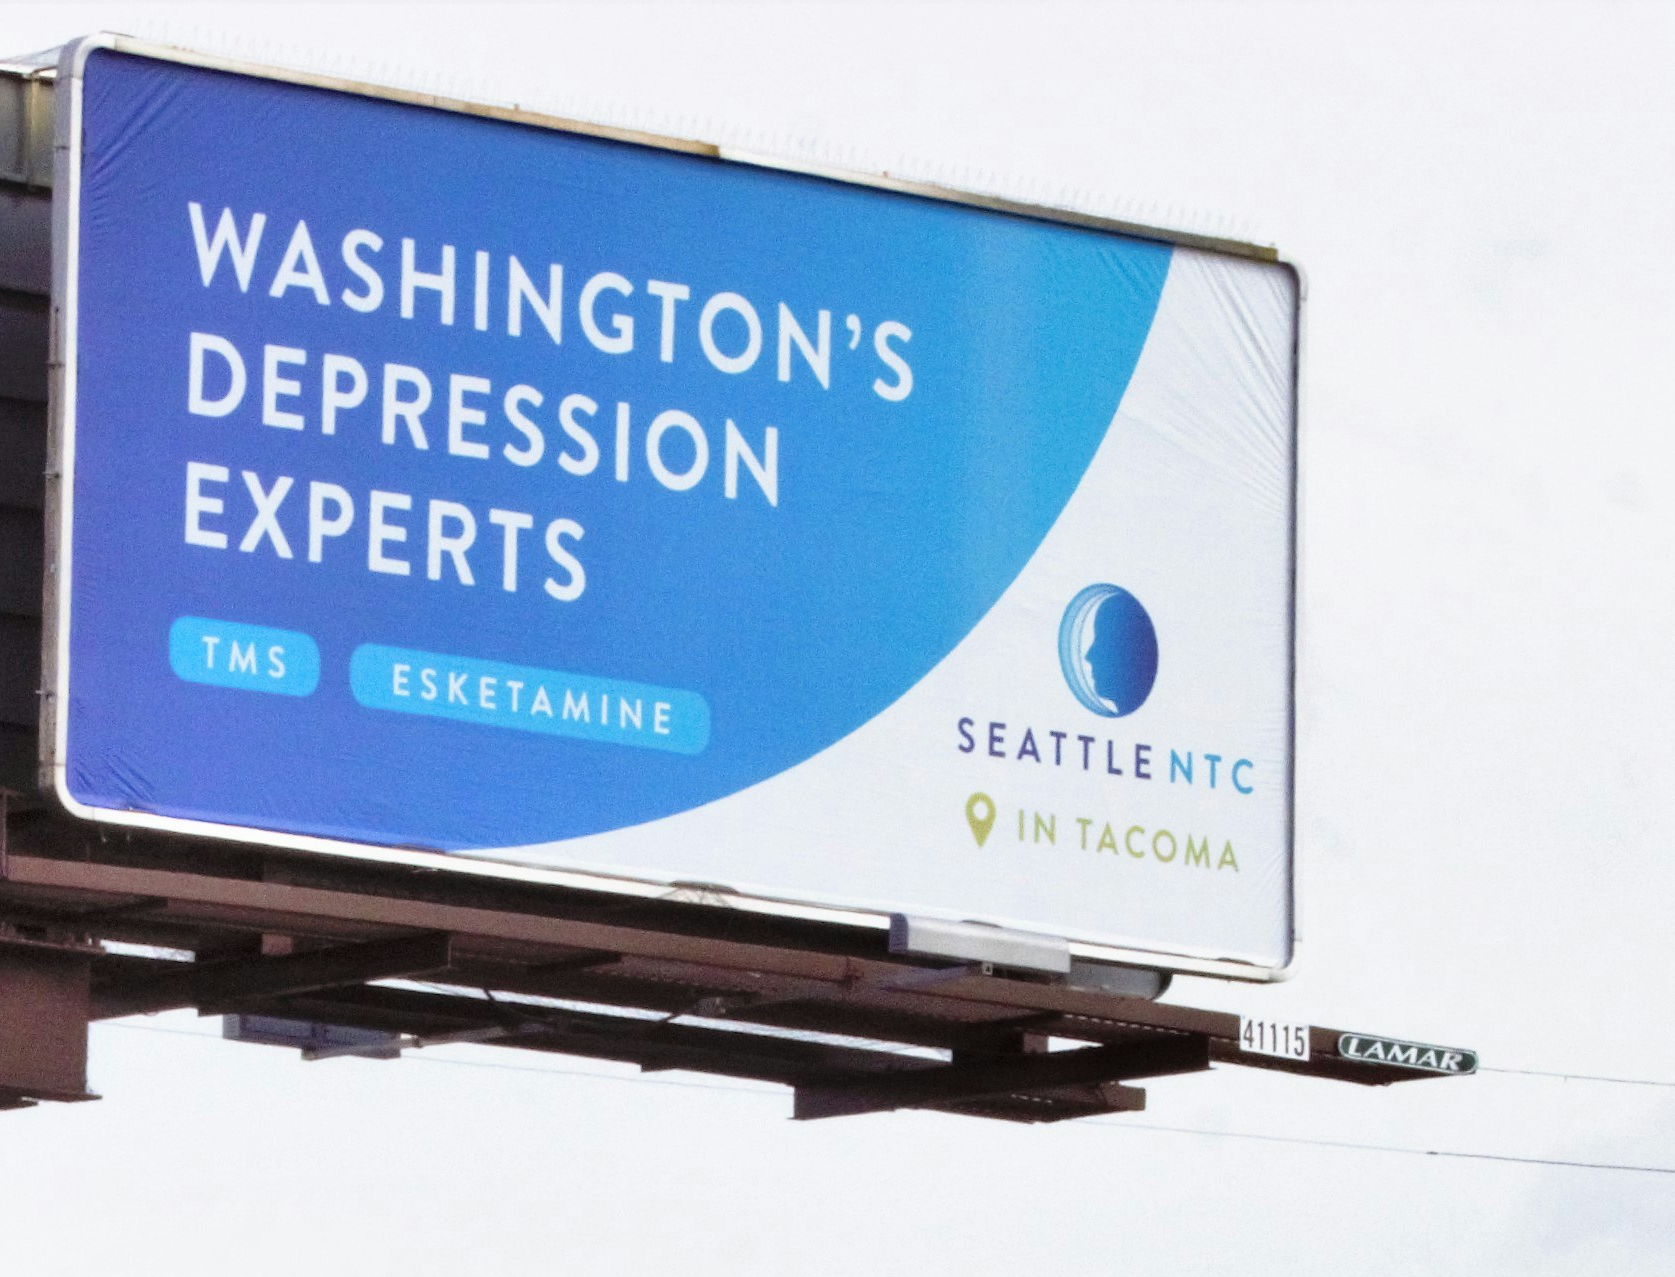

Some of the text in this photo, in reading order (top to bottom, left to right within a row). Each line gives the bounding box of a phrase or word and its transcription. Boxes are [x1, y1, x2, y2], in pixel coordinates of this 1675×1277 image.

[188, 201, 916, 403] WASHINGTON'S
[188, 331, 781, 508] DEPRESSION
[184, 461, 588, 603] EXPERTS
[202, 636, 289, 682] TMS
[391, 663, 674, 738] ESKETAMINE
[1018, 808, 1240, 873] IN TACOMA
[1241, 1017, 1307, 1058] 41115
[1343, 1035, 1466, 1073] LAMAR
